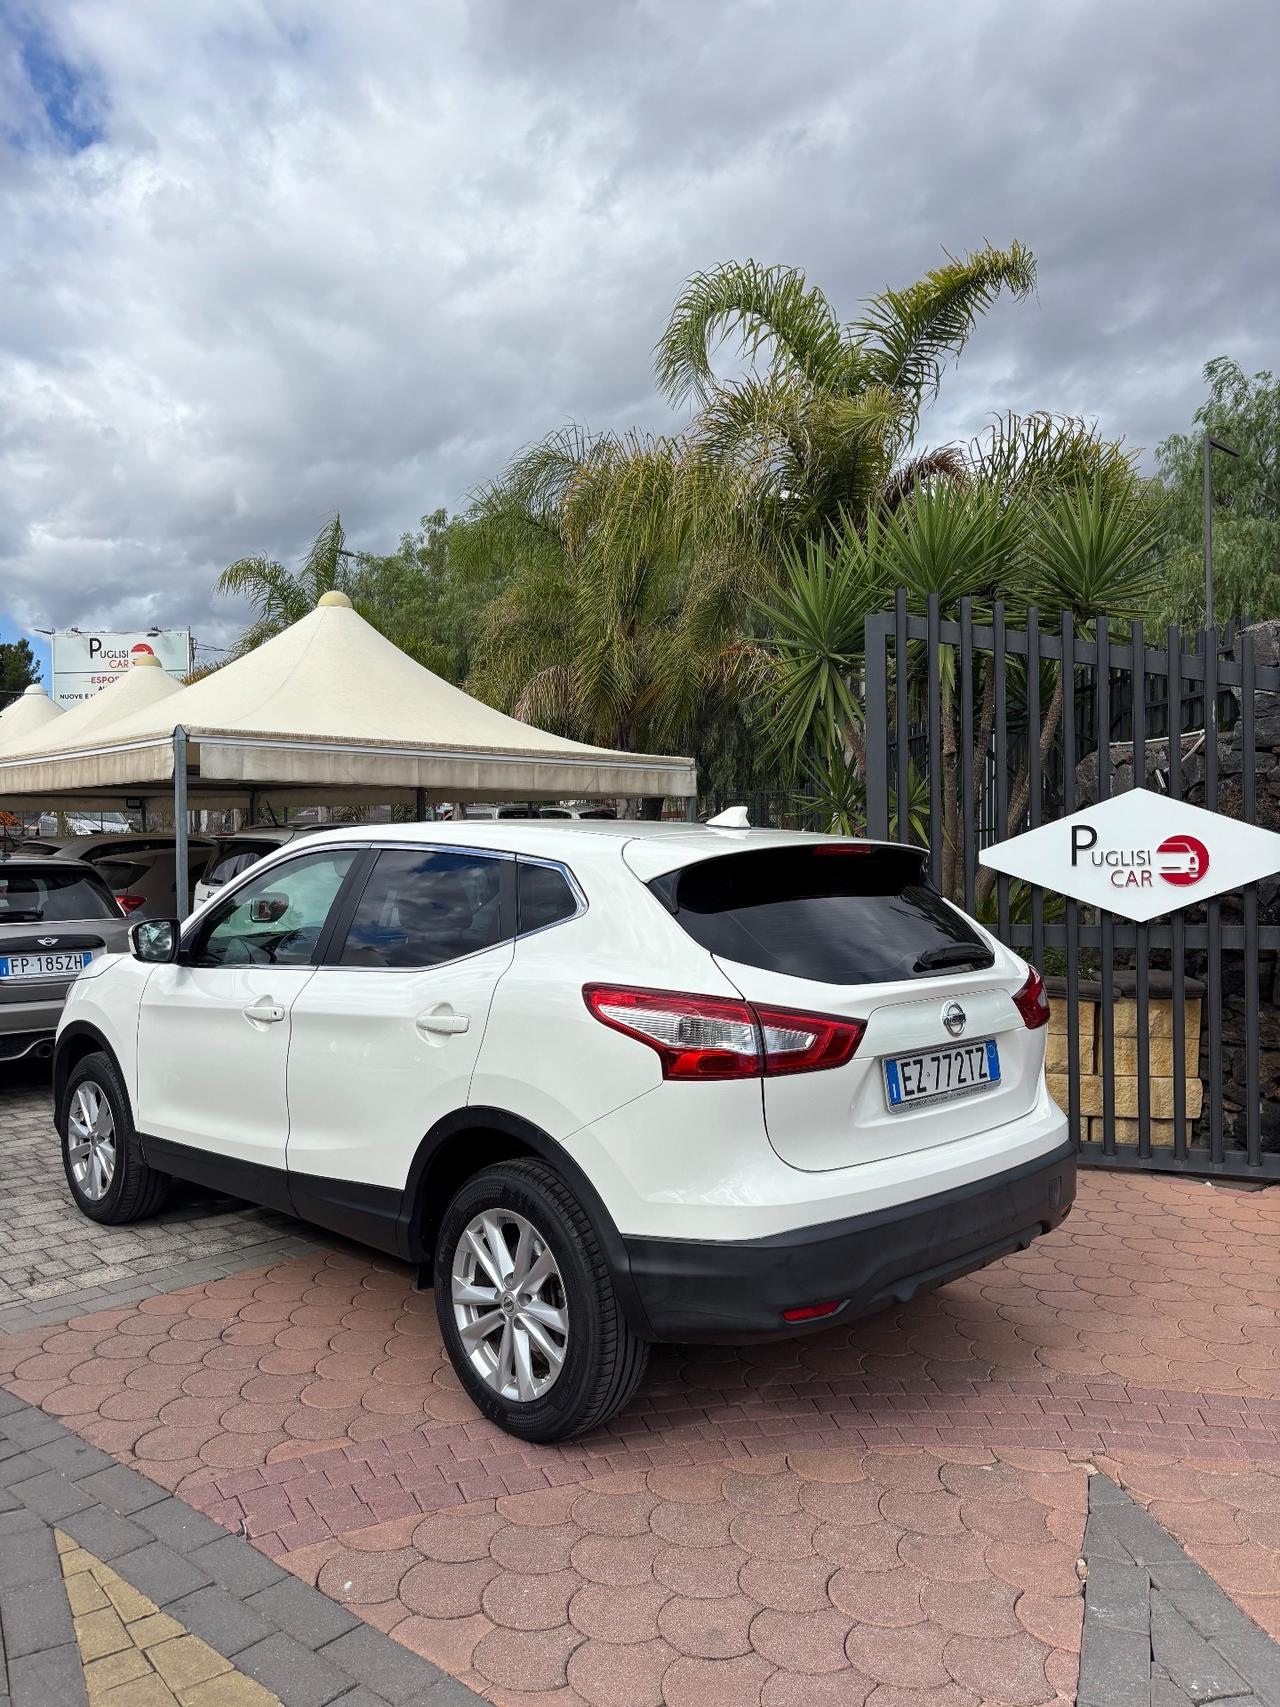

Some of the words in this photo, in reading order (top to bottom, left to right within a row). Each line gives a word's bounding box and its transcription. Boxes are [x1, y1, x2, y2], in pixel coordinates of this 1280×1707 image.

[89, 638, 128, 659] PUGLISI
[109, 660, 129, 668] CAR
[1071, 825, 1151, 867] PUGLISI
[1111, 870, 1153, 888] CAR
